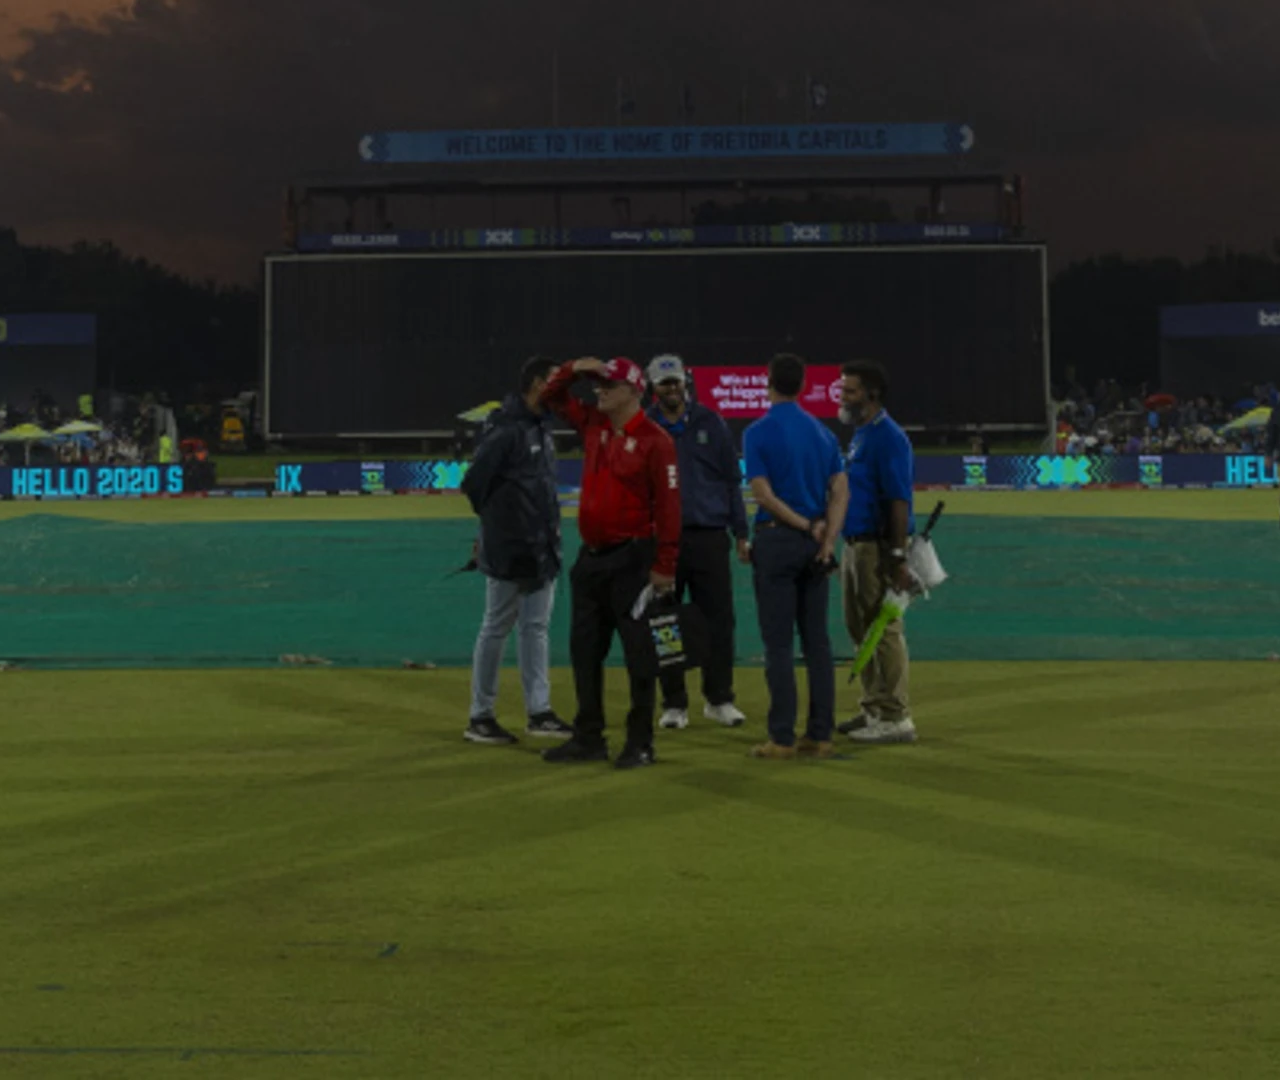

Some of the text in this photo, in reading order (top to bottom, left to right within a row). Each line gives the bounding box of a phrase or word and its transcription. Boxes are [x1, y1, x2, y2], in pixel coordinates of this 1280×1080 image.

[447, 128, 888, 156] WELCOME TO THE HOME OF PRETORIA CAPITALS
[11, 467, 90, 497] HELLO
[95, 465, 161, 496] 2020
